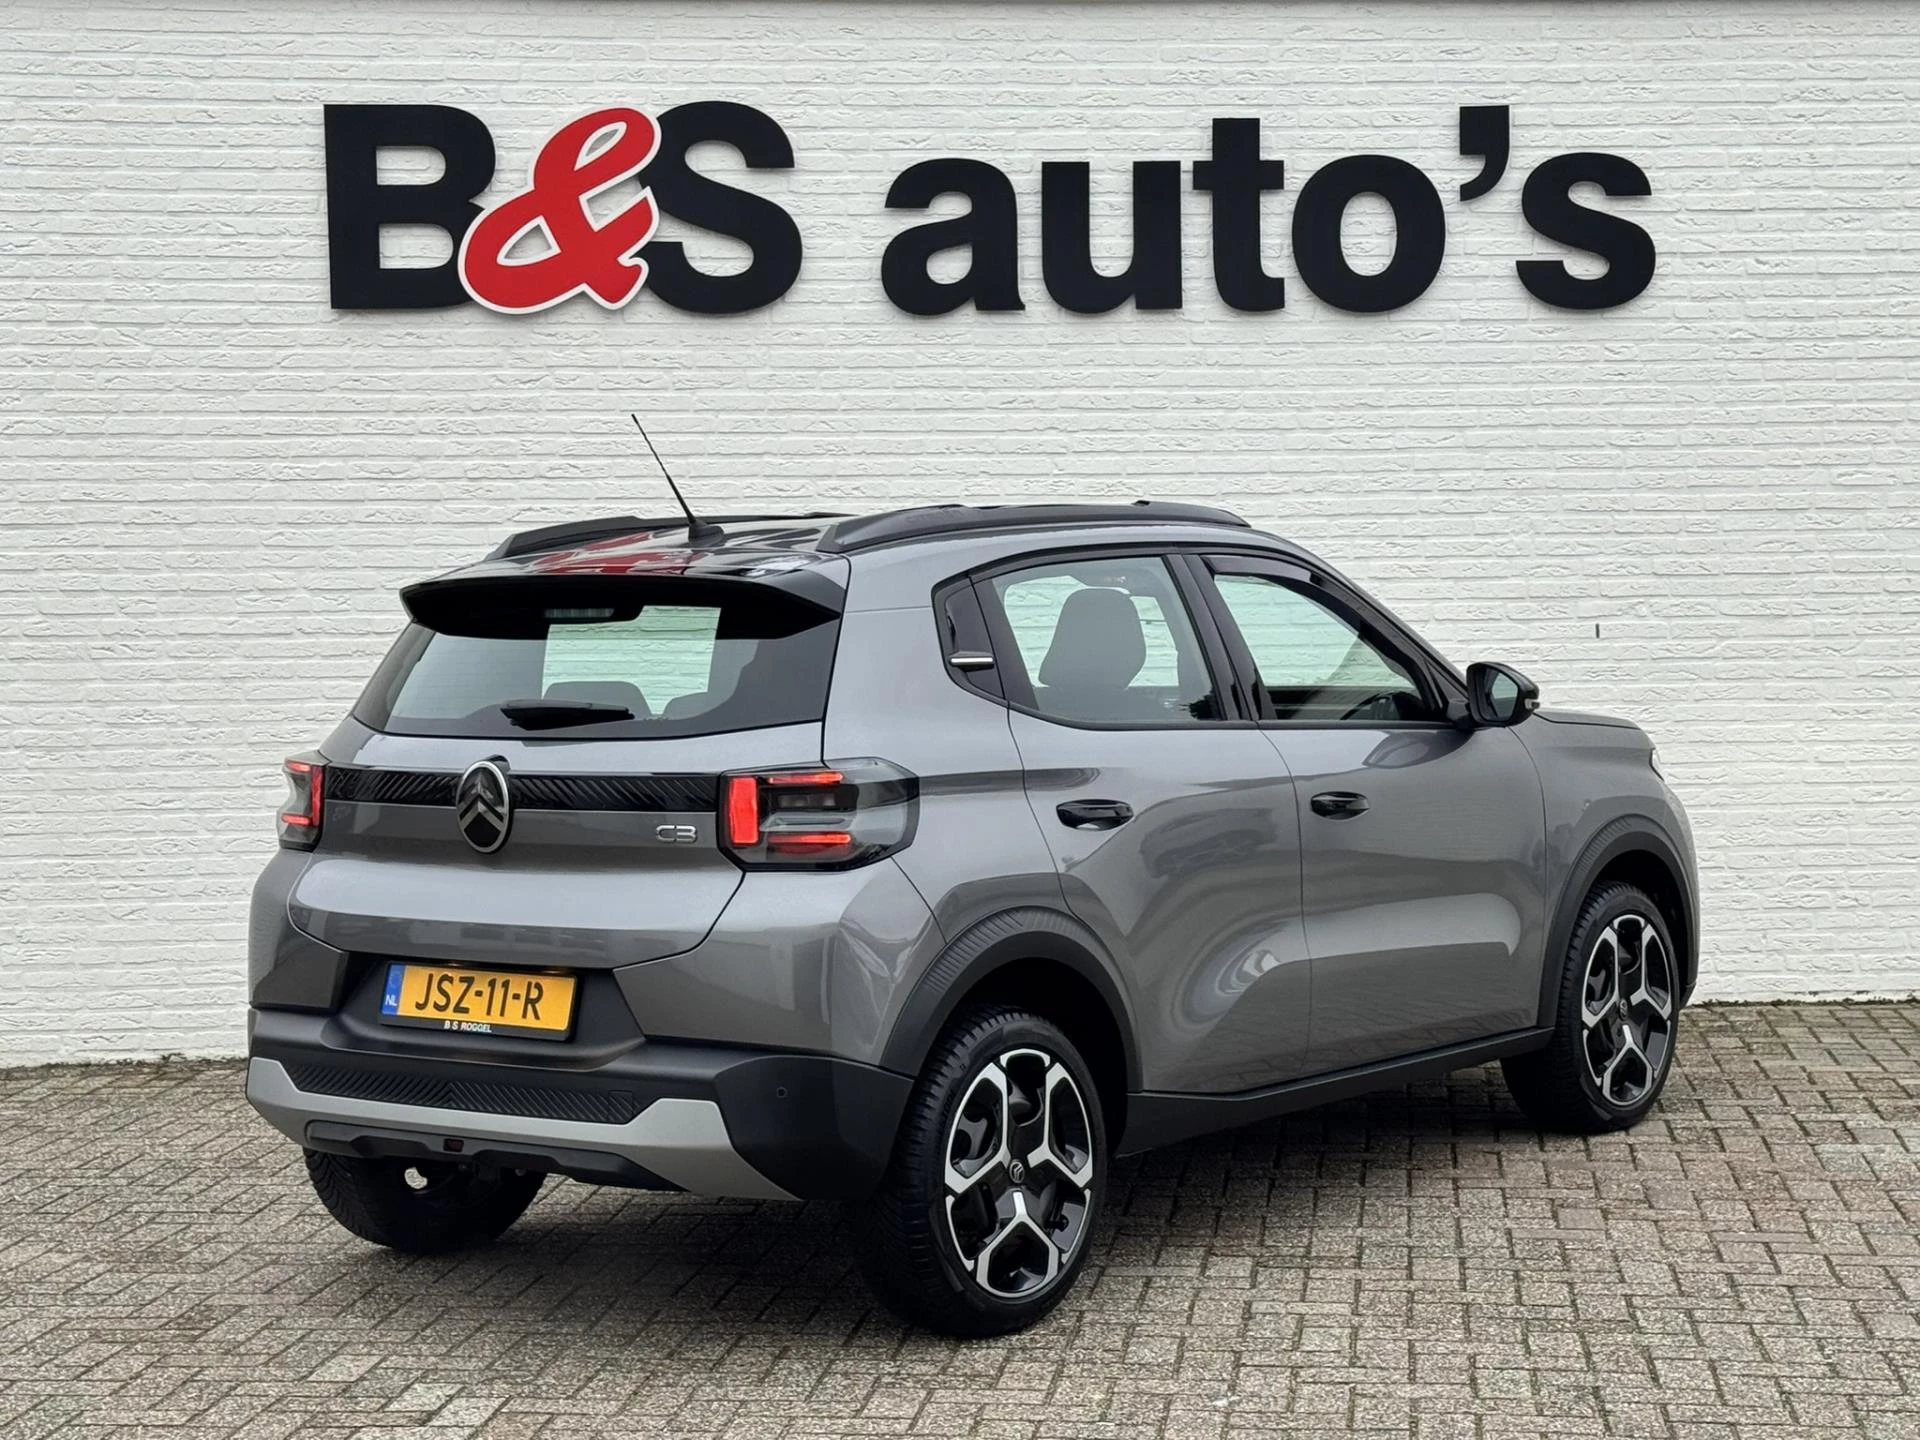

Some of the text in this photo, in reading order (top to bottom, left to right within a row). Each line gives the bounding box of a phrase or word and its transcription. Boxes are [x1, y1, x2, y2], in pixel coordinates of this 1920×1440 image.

[323, 101, 1656, 315] B&S auto's
[655, 824, 697, 843] C3
[384, 994, 398, 1007] NL
[414, 973, 544, 1021] JSZ-11-R
